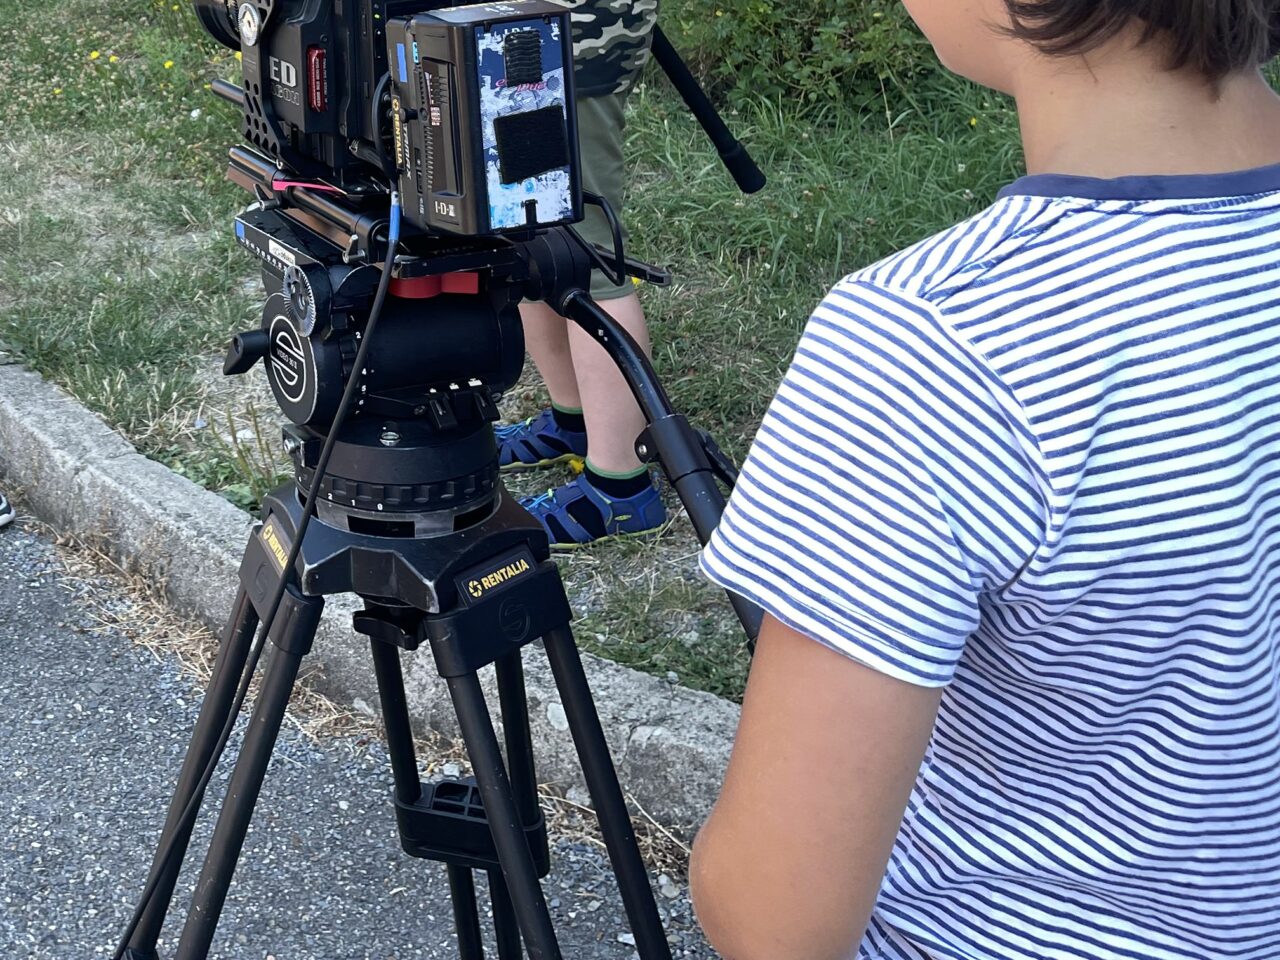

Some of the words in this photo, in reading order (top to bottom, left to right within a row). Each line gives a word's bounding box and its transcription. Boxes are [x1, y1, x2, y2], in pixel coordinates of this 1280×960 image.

[269, 55, 297, 87] ED
[394, 113, 403, 164] RENTALIA
[355, 331, 362, 339] 2
[361, 367, 368, 375] 4
[361, 384, 367, 392] 5
[327, 492, 333, 500] 2
[351, 499, 356, 507] 1
[376, 503, 384, 511] 0
[481, 558, 530, 590] RENTALIA
